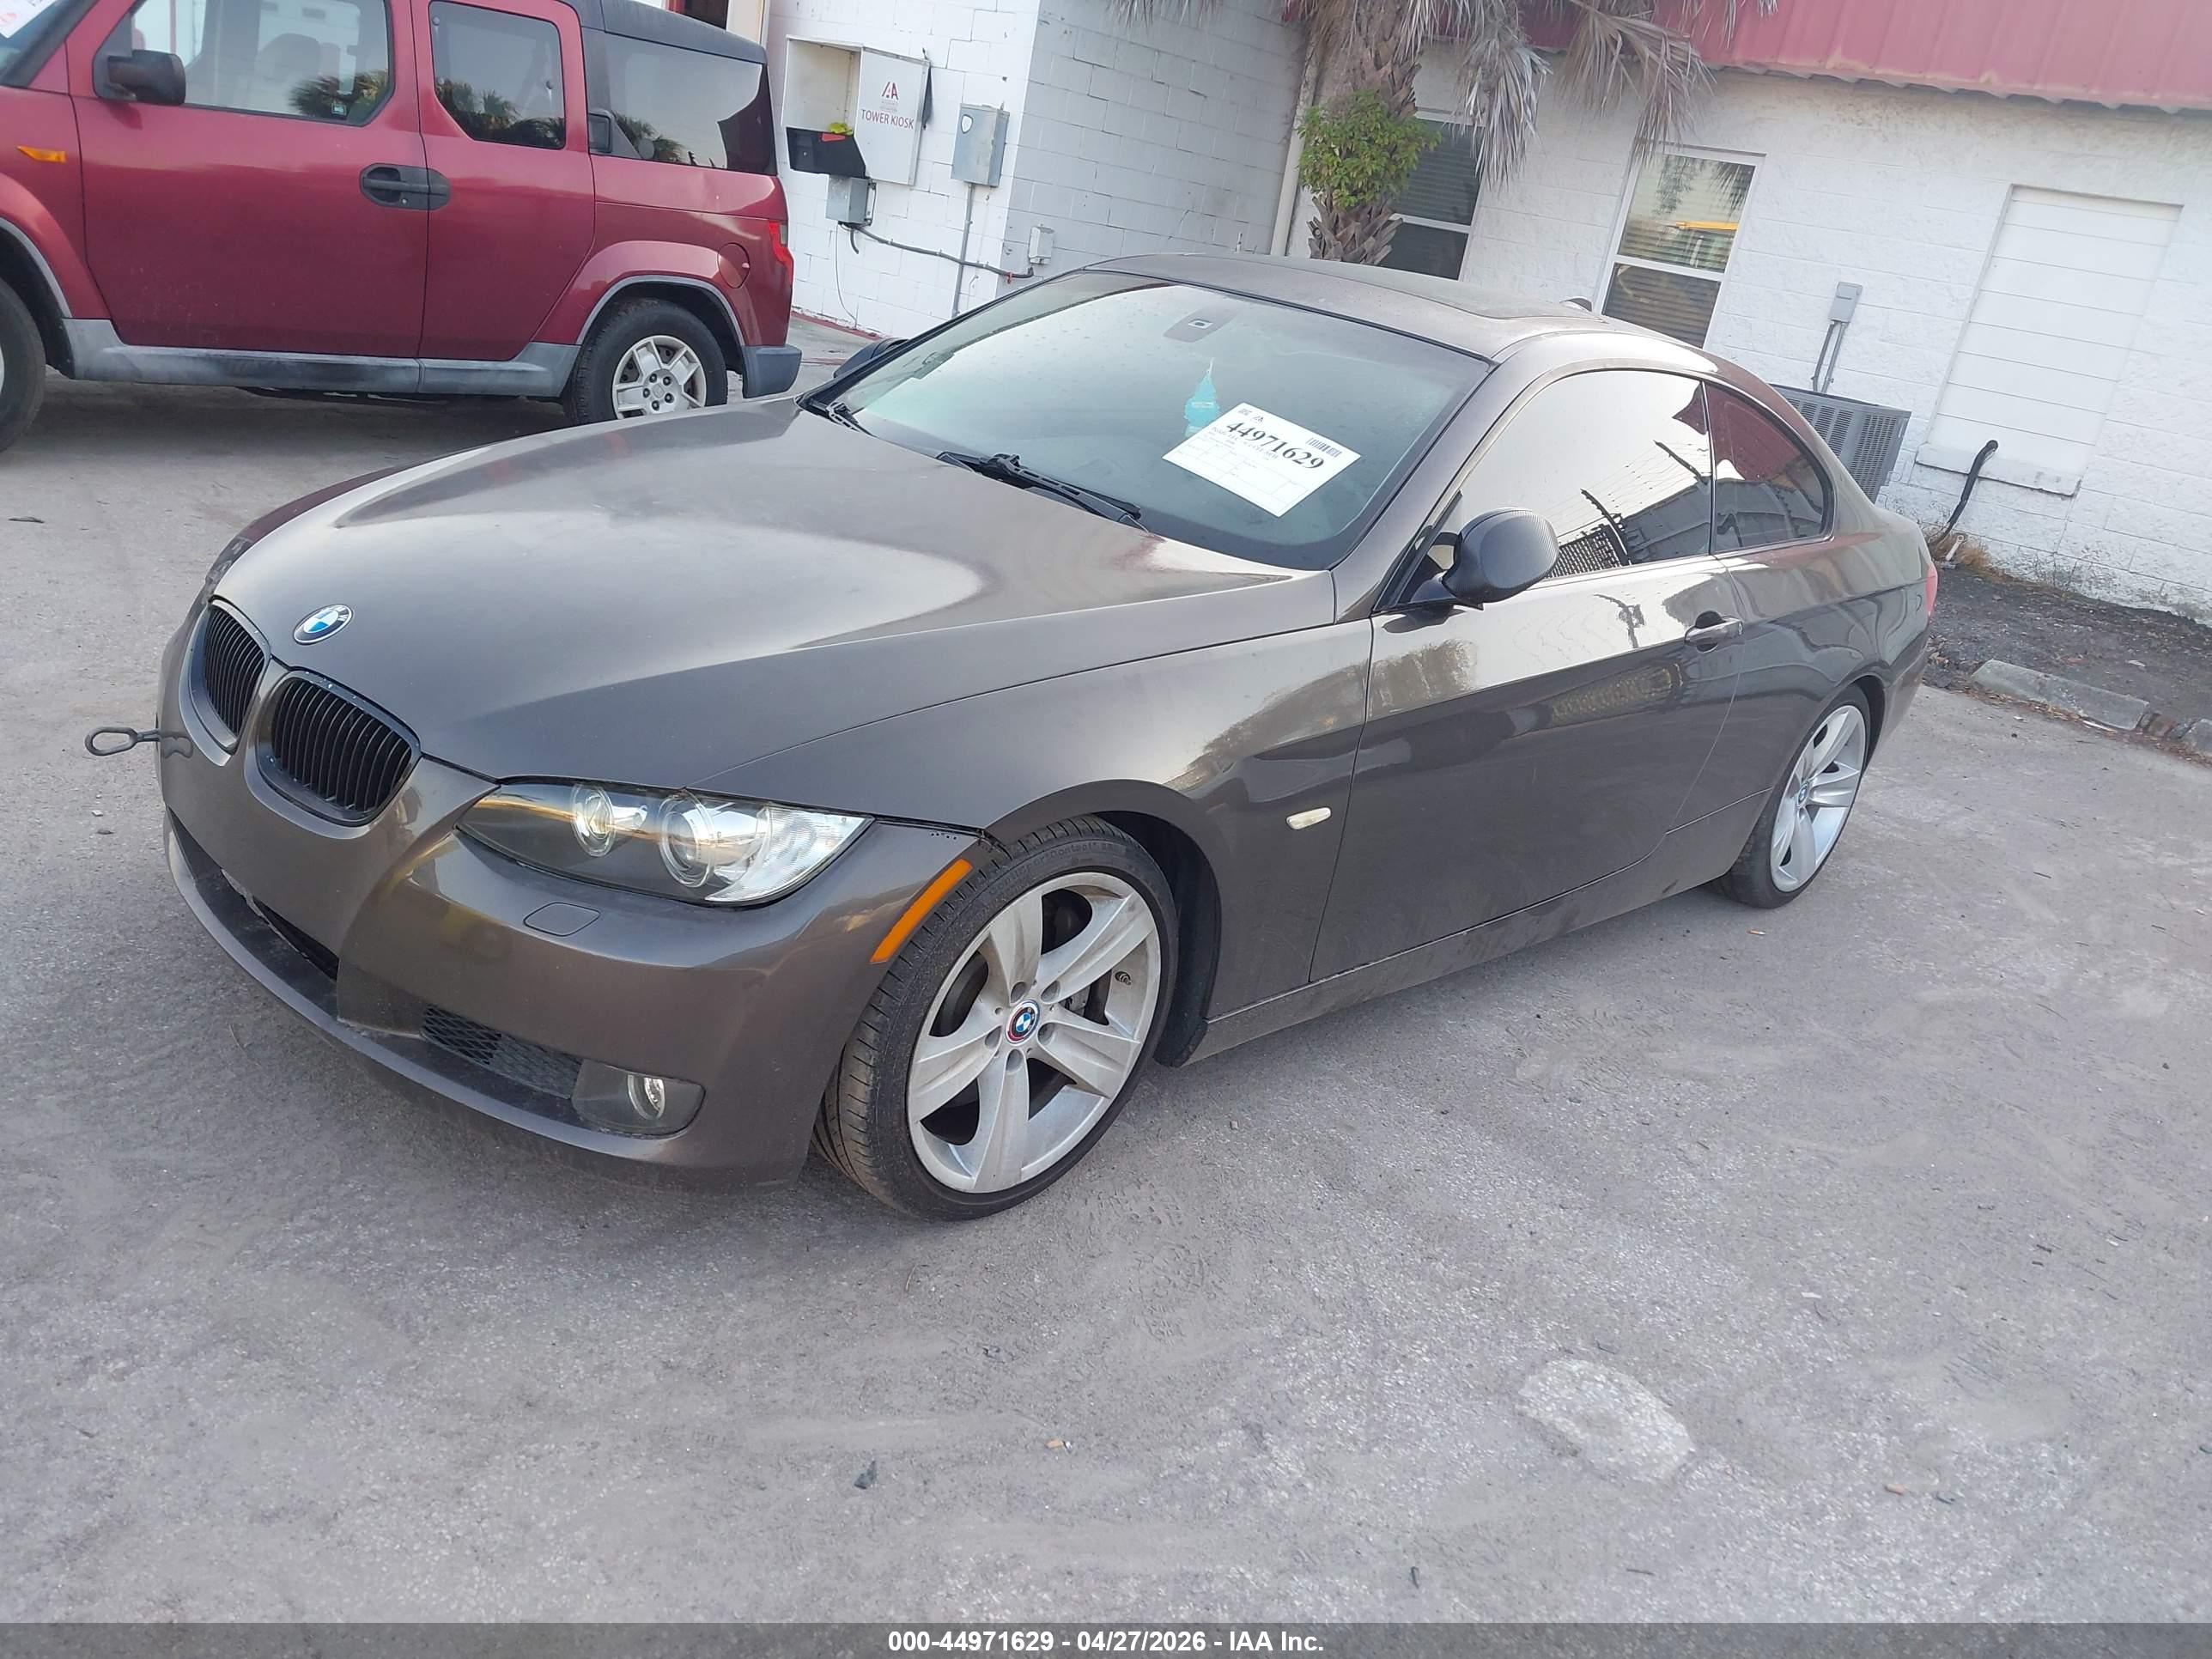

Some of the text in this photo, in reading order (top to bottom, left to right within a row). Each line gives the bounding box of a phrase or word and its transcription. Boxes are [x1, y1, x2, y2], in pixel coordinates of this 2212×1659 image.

[861, 109, 915, 130] TOWER KIOSK
[1226, 422, 1325, 470] 44971629
